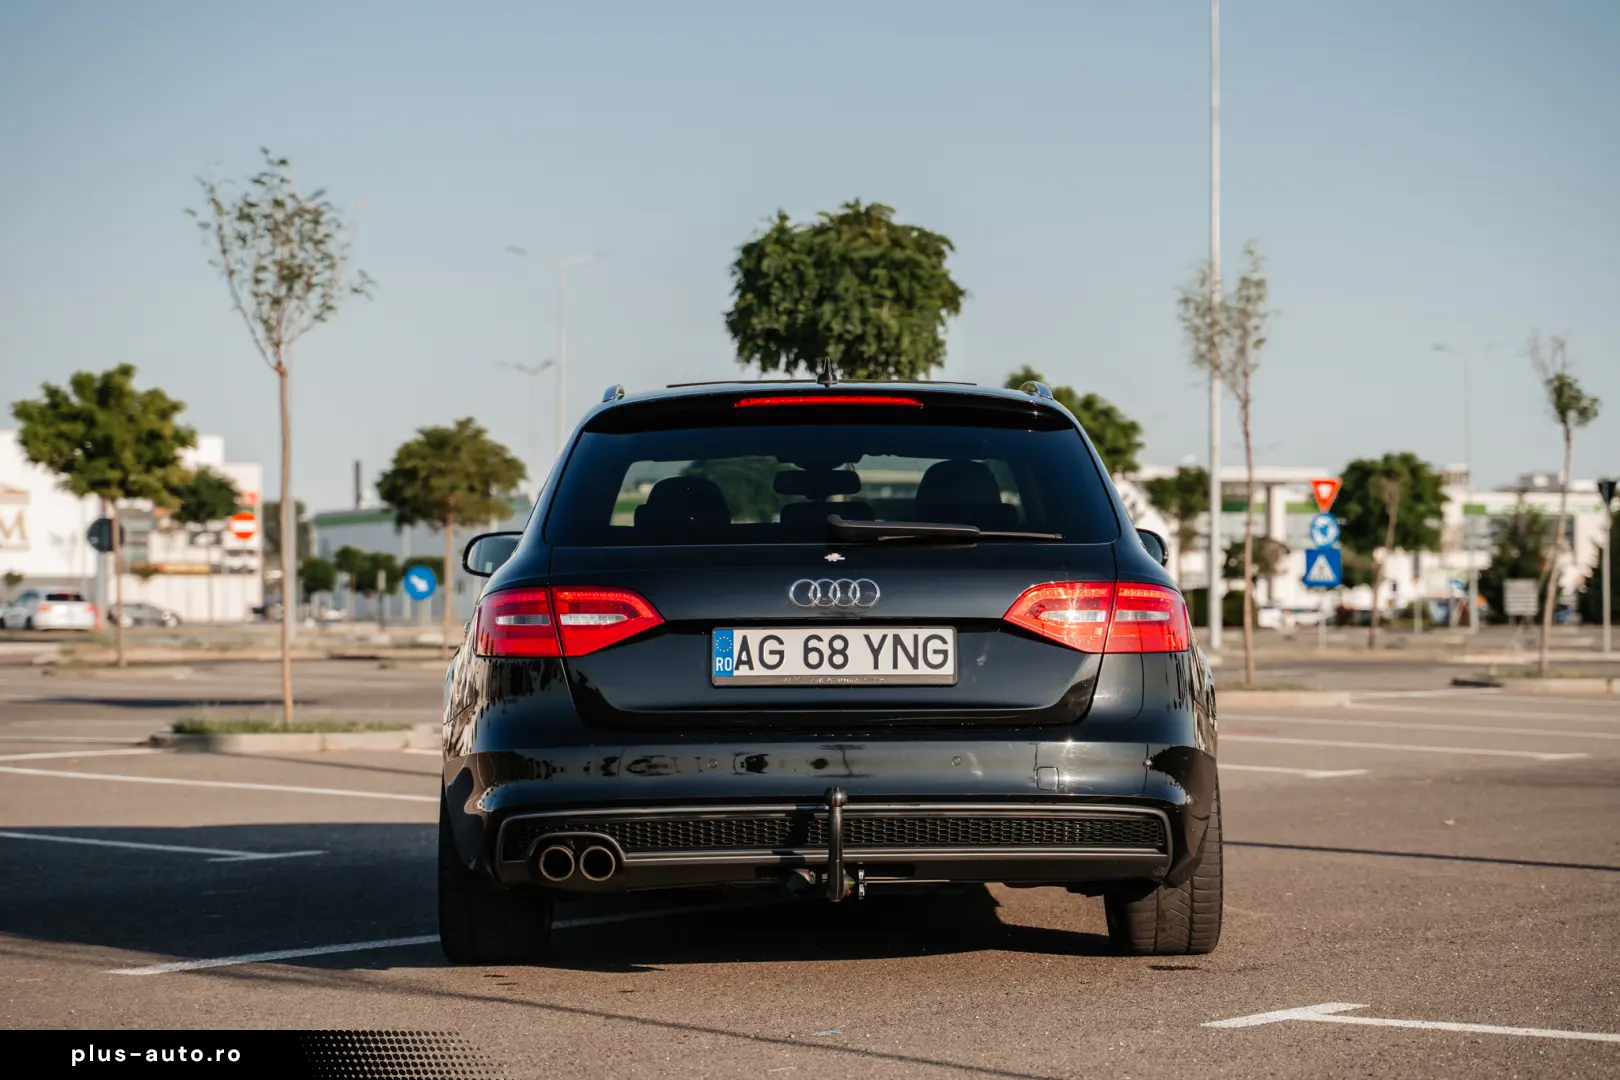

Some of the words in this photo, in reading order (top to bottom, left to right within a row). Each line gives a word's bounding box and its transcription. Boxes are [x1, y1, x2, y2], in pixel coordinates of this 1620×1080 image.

[715, 657, 733, 672] RO
[734, 634, 785, 671] AG
[803, 634, 850, 671] 68
[863, 634, 949, 671] YNG
